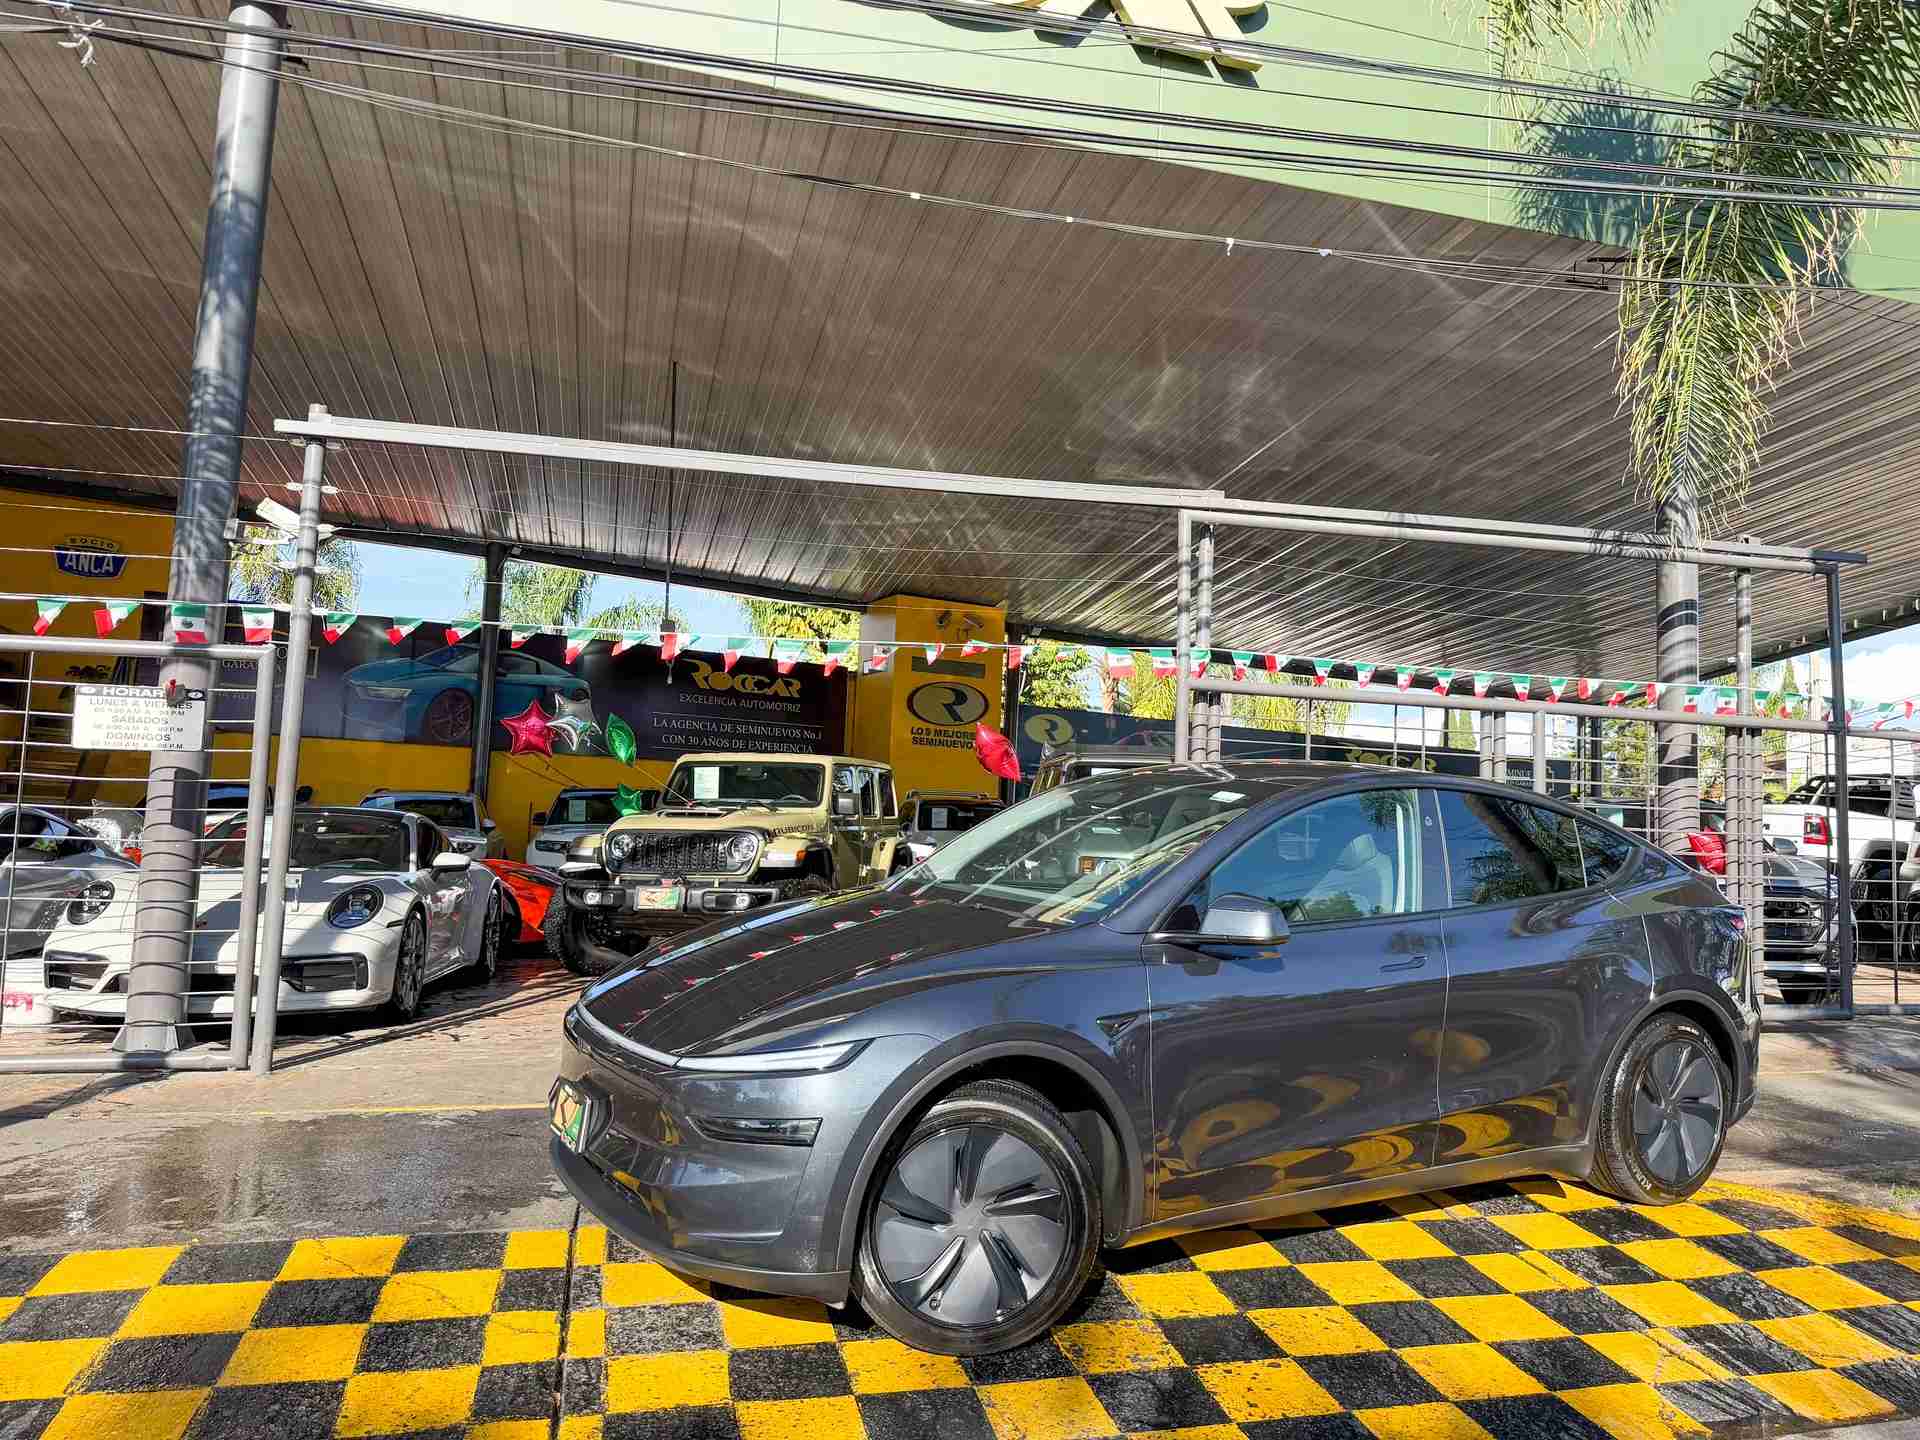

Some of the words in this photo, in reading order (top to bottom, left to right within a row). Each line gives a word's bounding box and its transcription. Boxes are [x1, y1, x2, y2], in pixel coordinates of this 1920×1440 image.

[64, 549, 114, 573] ANCA
[680, 658, 801, 698] ROCCAR
[679, 693, 737, 708] EXCELENCIA
[740, 700, 801, 713] AUTOMOTRIZ
[653, 717, 669, 728] LA
[669, 718, 719, 732] AGENCIA
[720, 724, 735, 734] DE
[736, 724, 801, 739] SEMINUEVOS
[911, 726, 931, 736] LOS
[661, 734, 686, 745] CON
[687, 736, 699, 746] 30
[700, 735, 730, 748] AÑOS
[731, 740, 747, 750] DE
[748, 740, 814, 754] EXPERIENCIA
